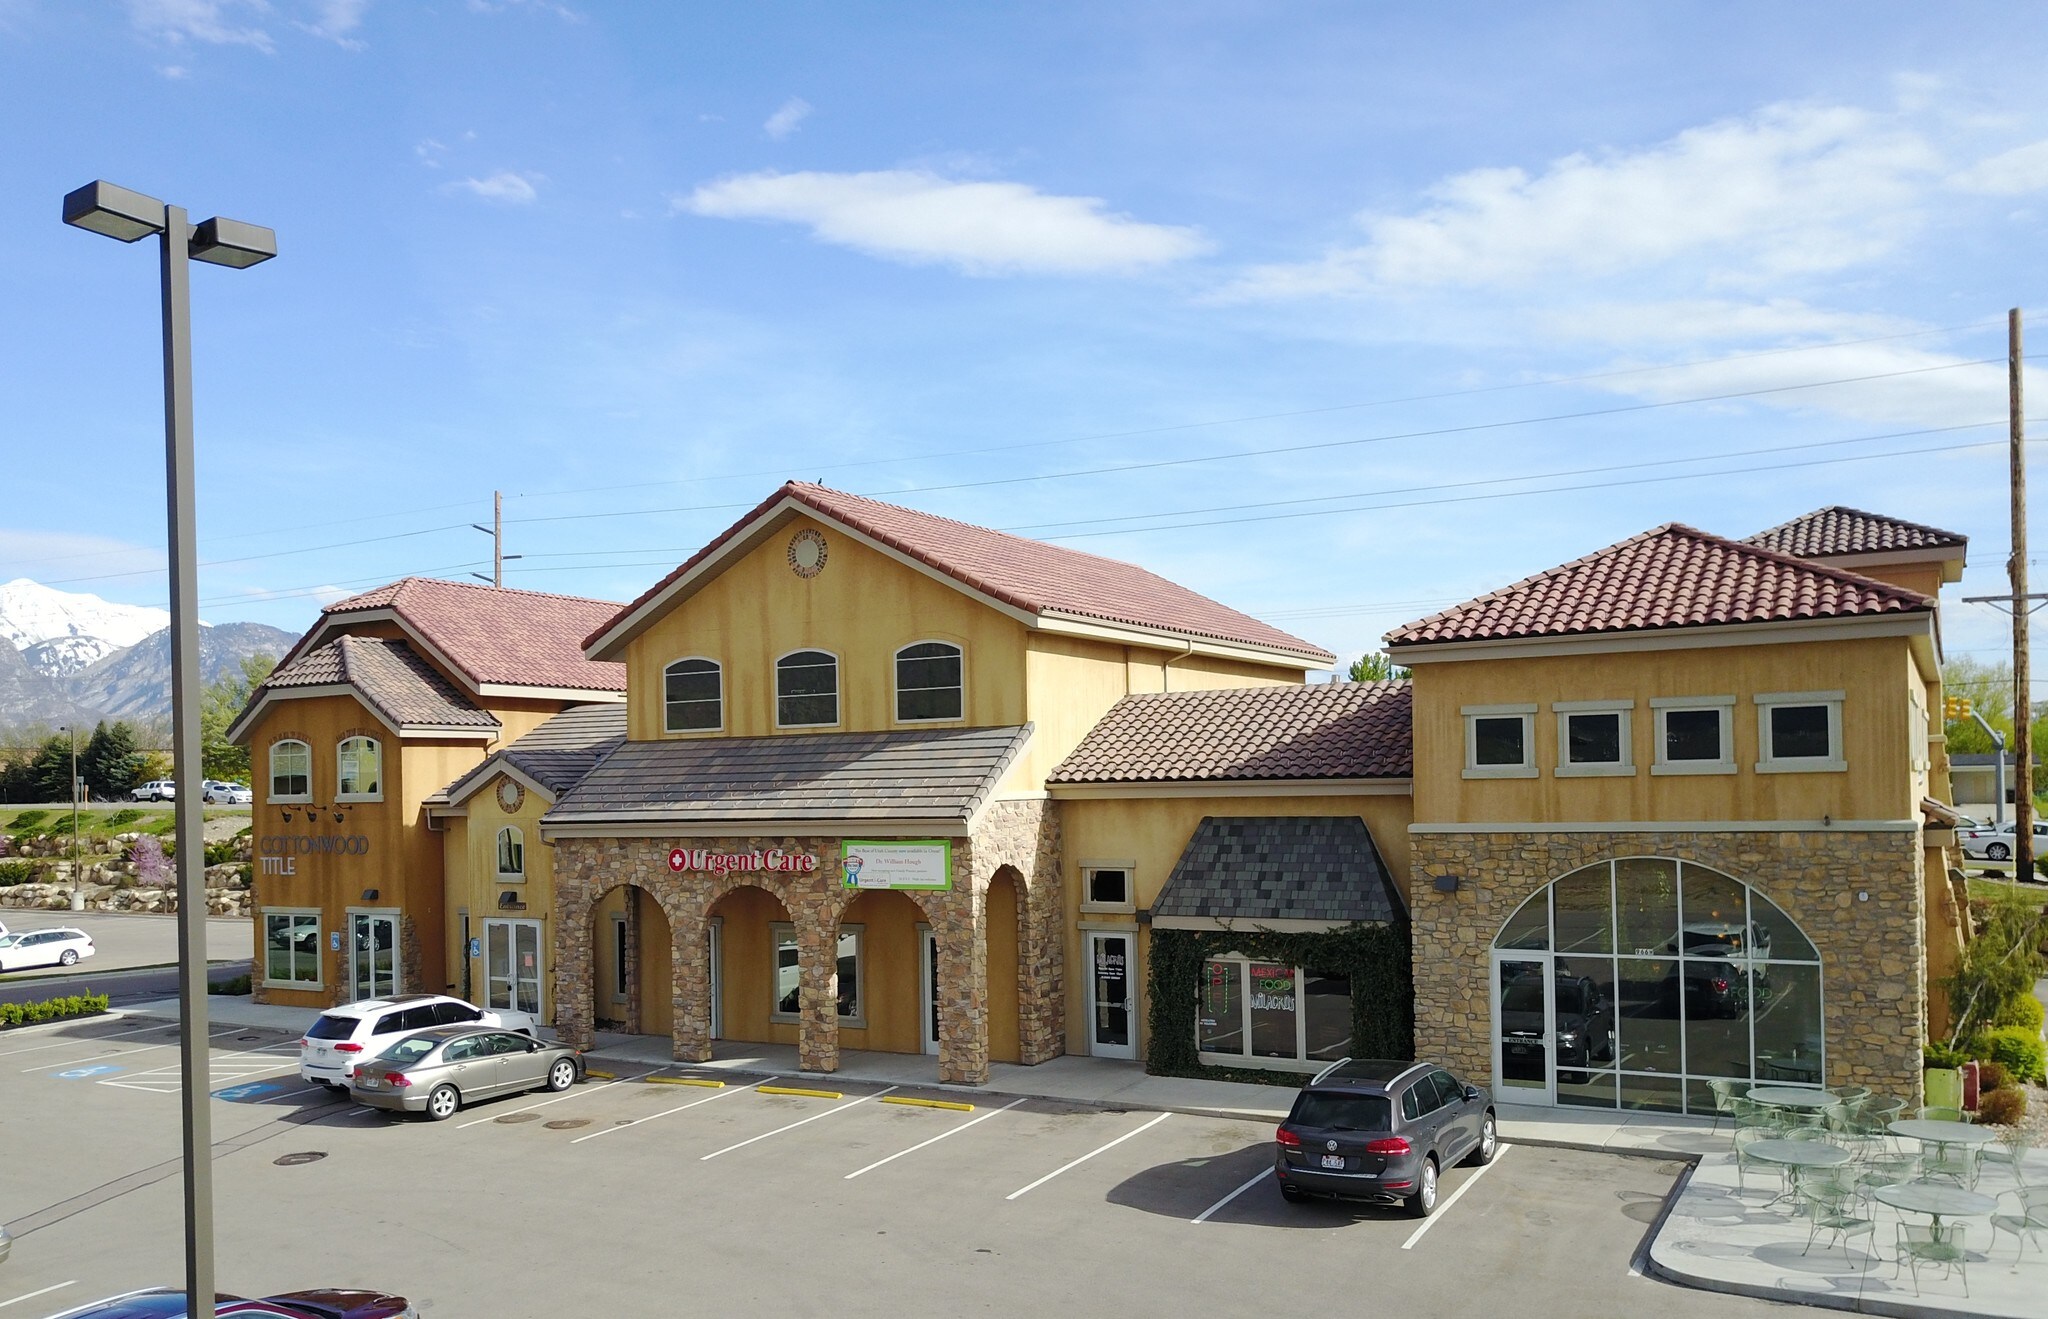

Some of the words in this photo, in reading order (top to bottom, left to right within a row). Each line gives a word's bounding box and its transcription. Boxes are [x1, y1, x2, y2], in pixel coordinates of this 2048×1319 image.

[261, 835, 369, 855] COTTONWOOD
[260, 857, 296, 875] TITLE
[689, 848, 759, 875] Urgent
[763, 848, 815, 871] Care
[1251, 967, 1295, 978] MEXICAN
[1259, 979, 1291, 991] FOOD
[1730, 986, 1773, 1000] FOOD
[1250, 992, 1295, 1011] MILAGROS
